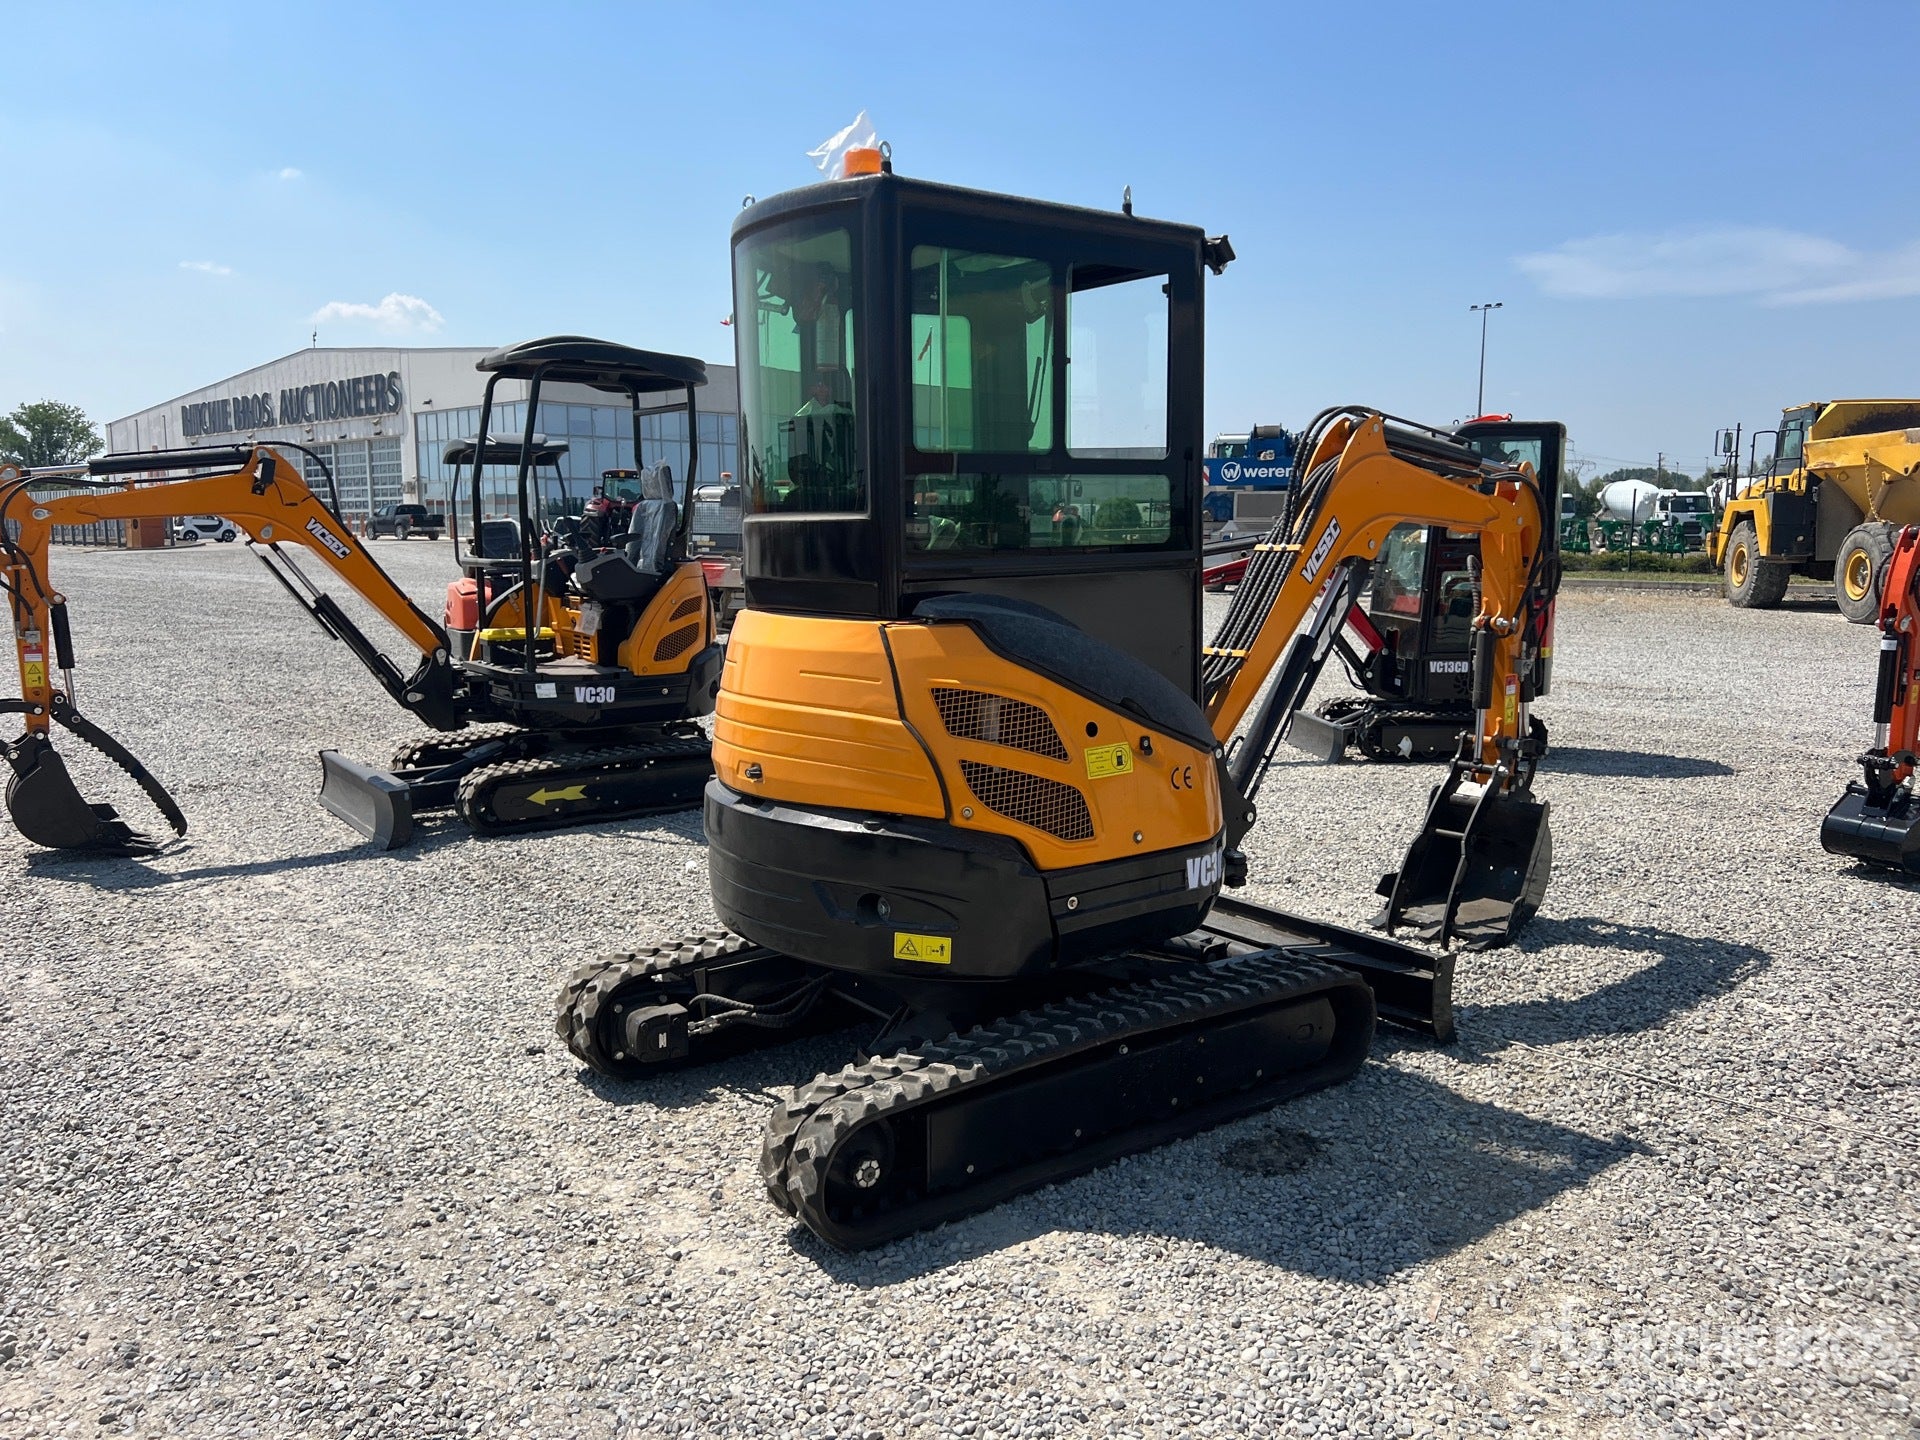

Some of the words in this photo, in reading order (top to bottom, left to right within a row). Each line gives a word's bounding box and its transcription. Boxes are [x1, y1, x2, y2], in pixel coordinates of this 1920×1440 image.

[181, 399, 232, 436] RITCHIE
[280, 371, 402, 425] AUCTIONEERS
[306, 516, 351, 559] VICSEC
[1301, 516, 1341, 583] VICSEC
[1429, 661, 1469, 673] VC13CD
[574, 686, 616, 703] VC30
[1171, 766, 1193, 790] CE
